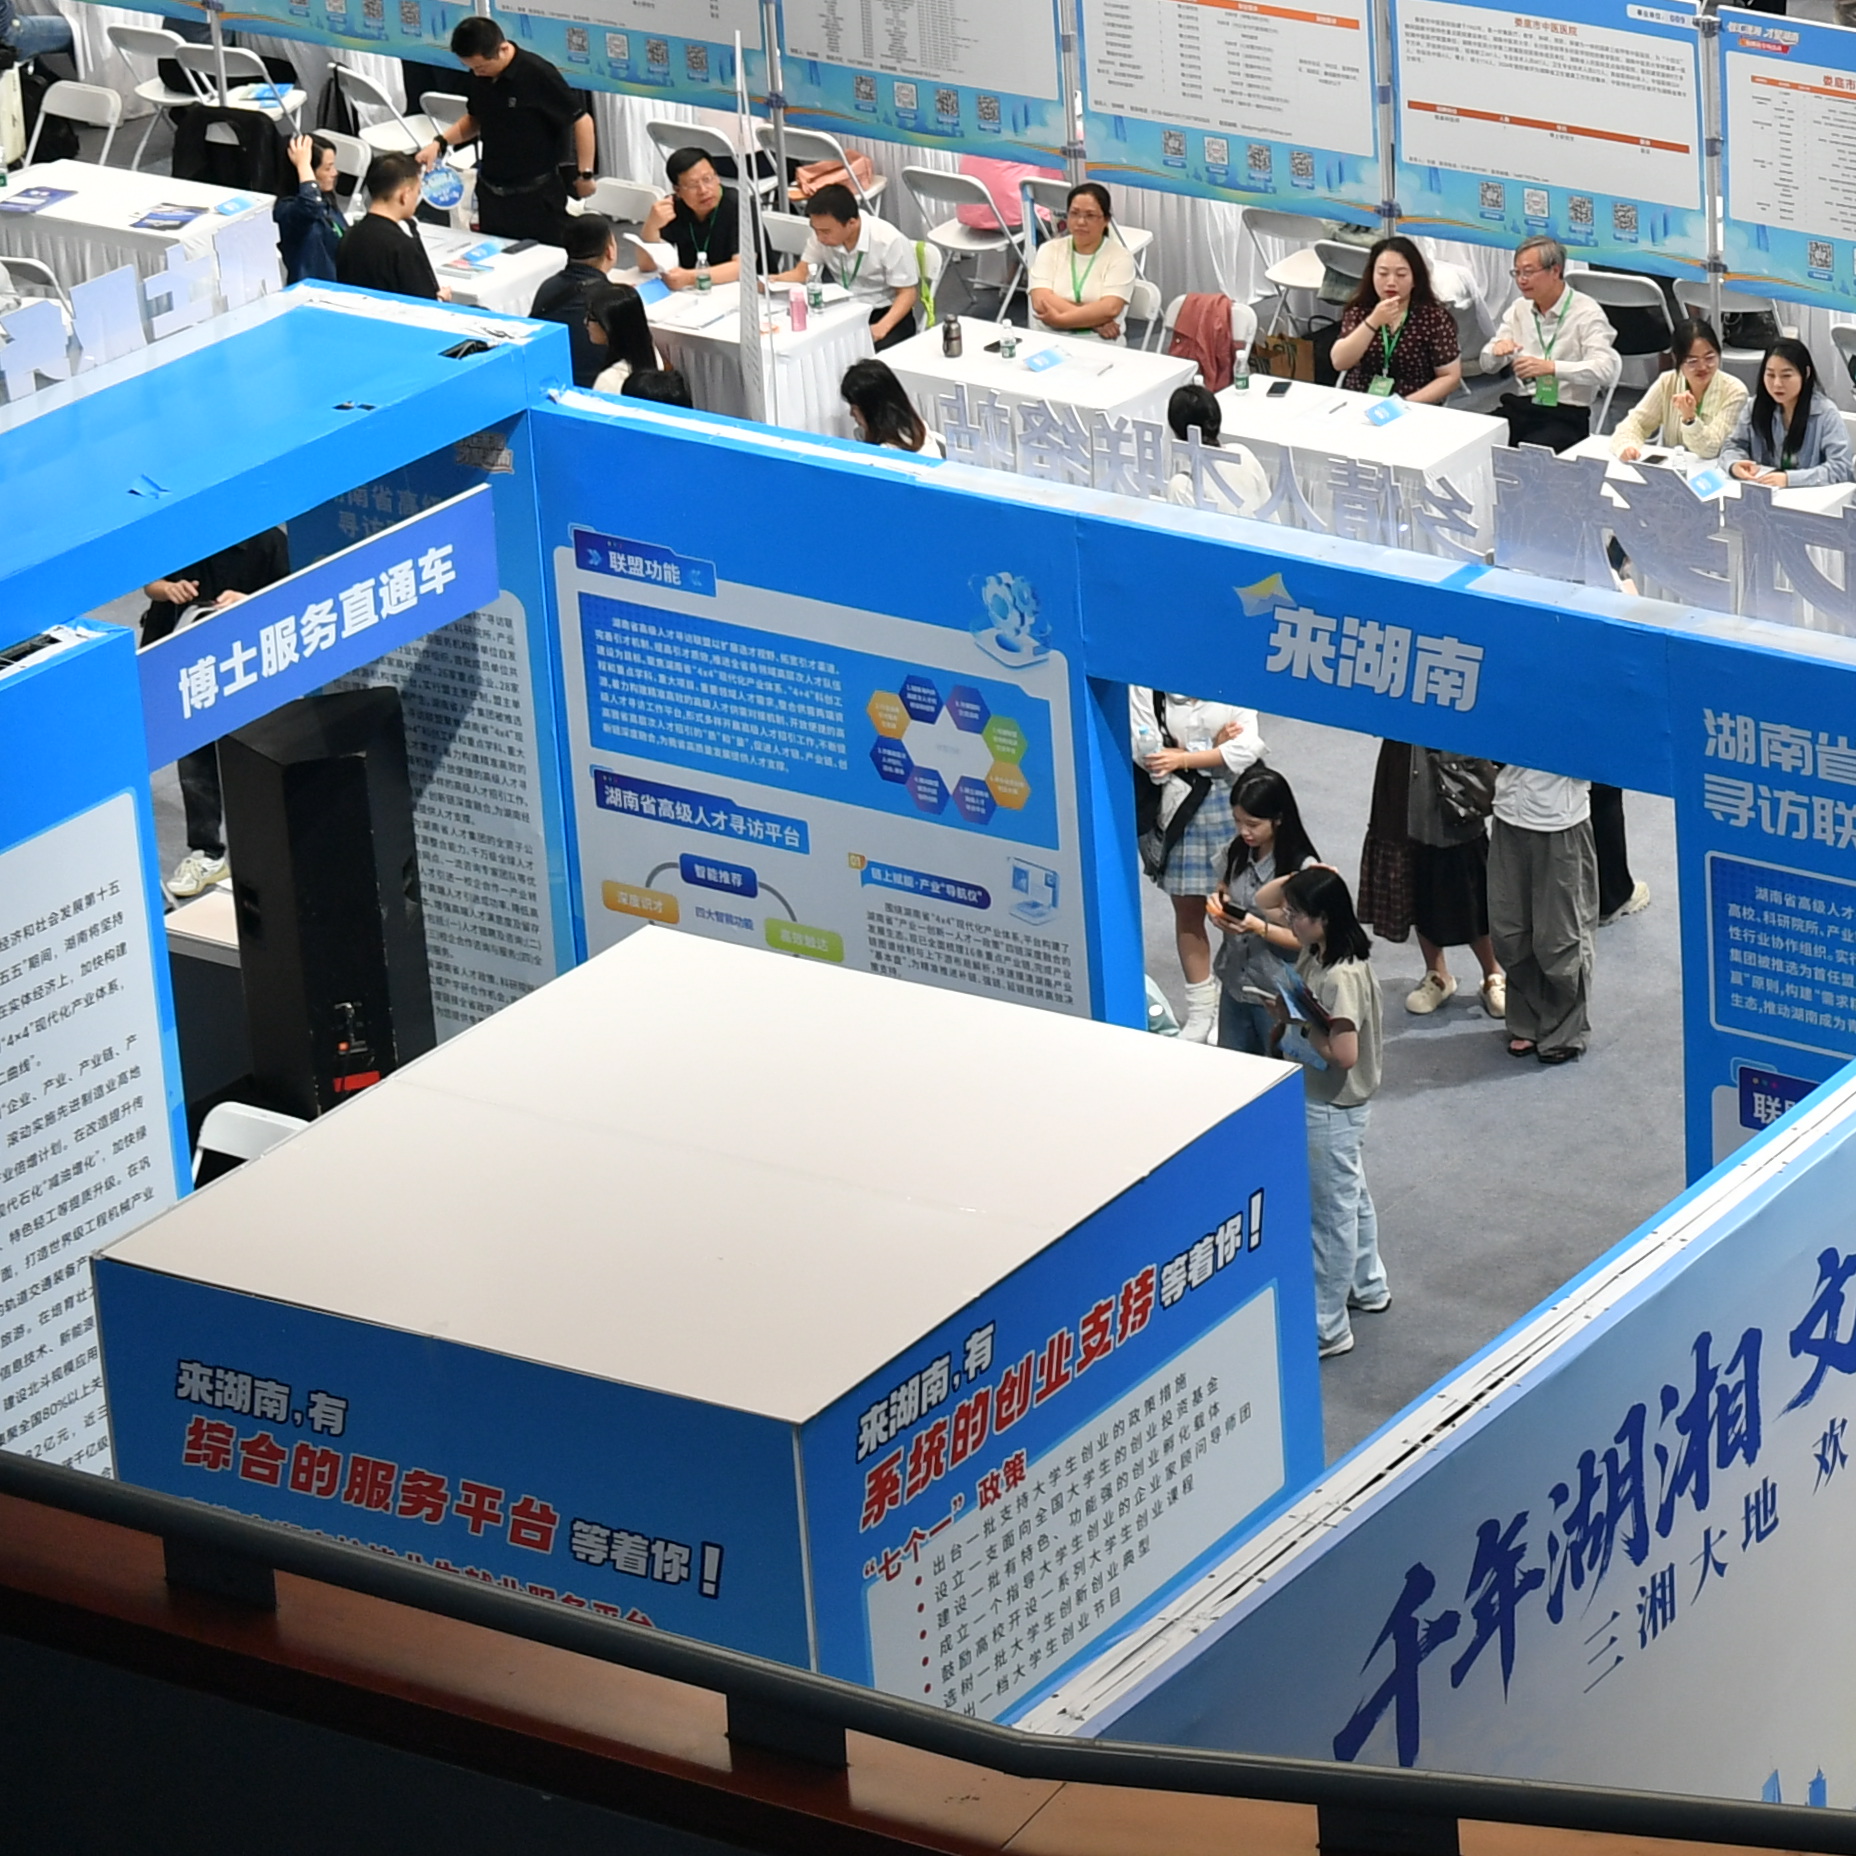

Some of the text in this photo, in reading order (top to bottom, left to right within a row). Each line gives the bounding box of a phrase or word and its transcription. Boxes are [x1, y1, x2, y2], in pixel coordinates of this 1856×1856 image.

[1514, 17, 1578, 36] 娄底市中医医院
[177, 543, 457, 721] 博士服务直通车
[610, 547, 682, 586] 联盟功能
[1265, 602, 1485, 714] 来湖南
[605, 785, 799, 847] 湖南省高级人才寻访平台
[694, 864, 742, 887] 智能推荐
[0, 1096, 144, 1185] 业倍增计划。在改造提升传
[859, 1187, 1264, 1533] 系统的创业支持 等着你！
[184, 1416, 559, 1554] 综合的服务平台
[570, 1518, 722, 1599] 等着你！
[865, 1450, 1027, 1580] “七个一” 政策
[933, 1372, 1187, 1577] 出台一批支持大学生创业的政策措施
[934, 1375, 1220, 1603] 设立一支面向全国大学生的创业投资基金
[937, 1401, 1220, 1630] 建设一批有特色、功能强的创业孵化载体
[939, 1402, 1252, 1657] 成立一个指导大学生创业的企业家顾问导师团
[1333, 1326, 1764, 1765] 千年湖湘
[941, 1474, 1195, 1684] 鼓励高校开设一系列大学生创业课程
[943, 1535, 1151, 1709] 选树一批大学生创新创业典型
[1582, 1475, 1782, 1693] 三湘大地
